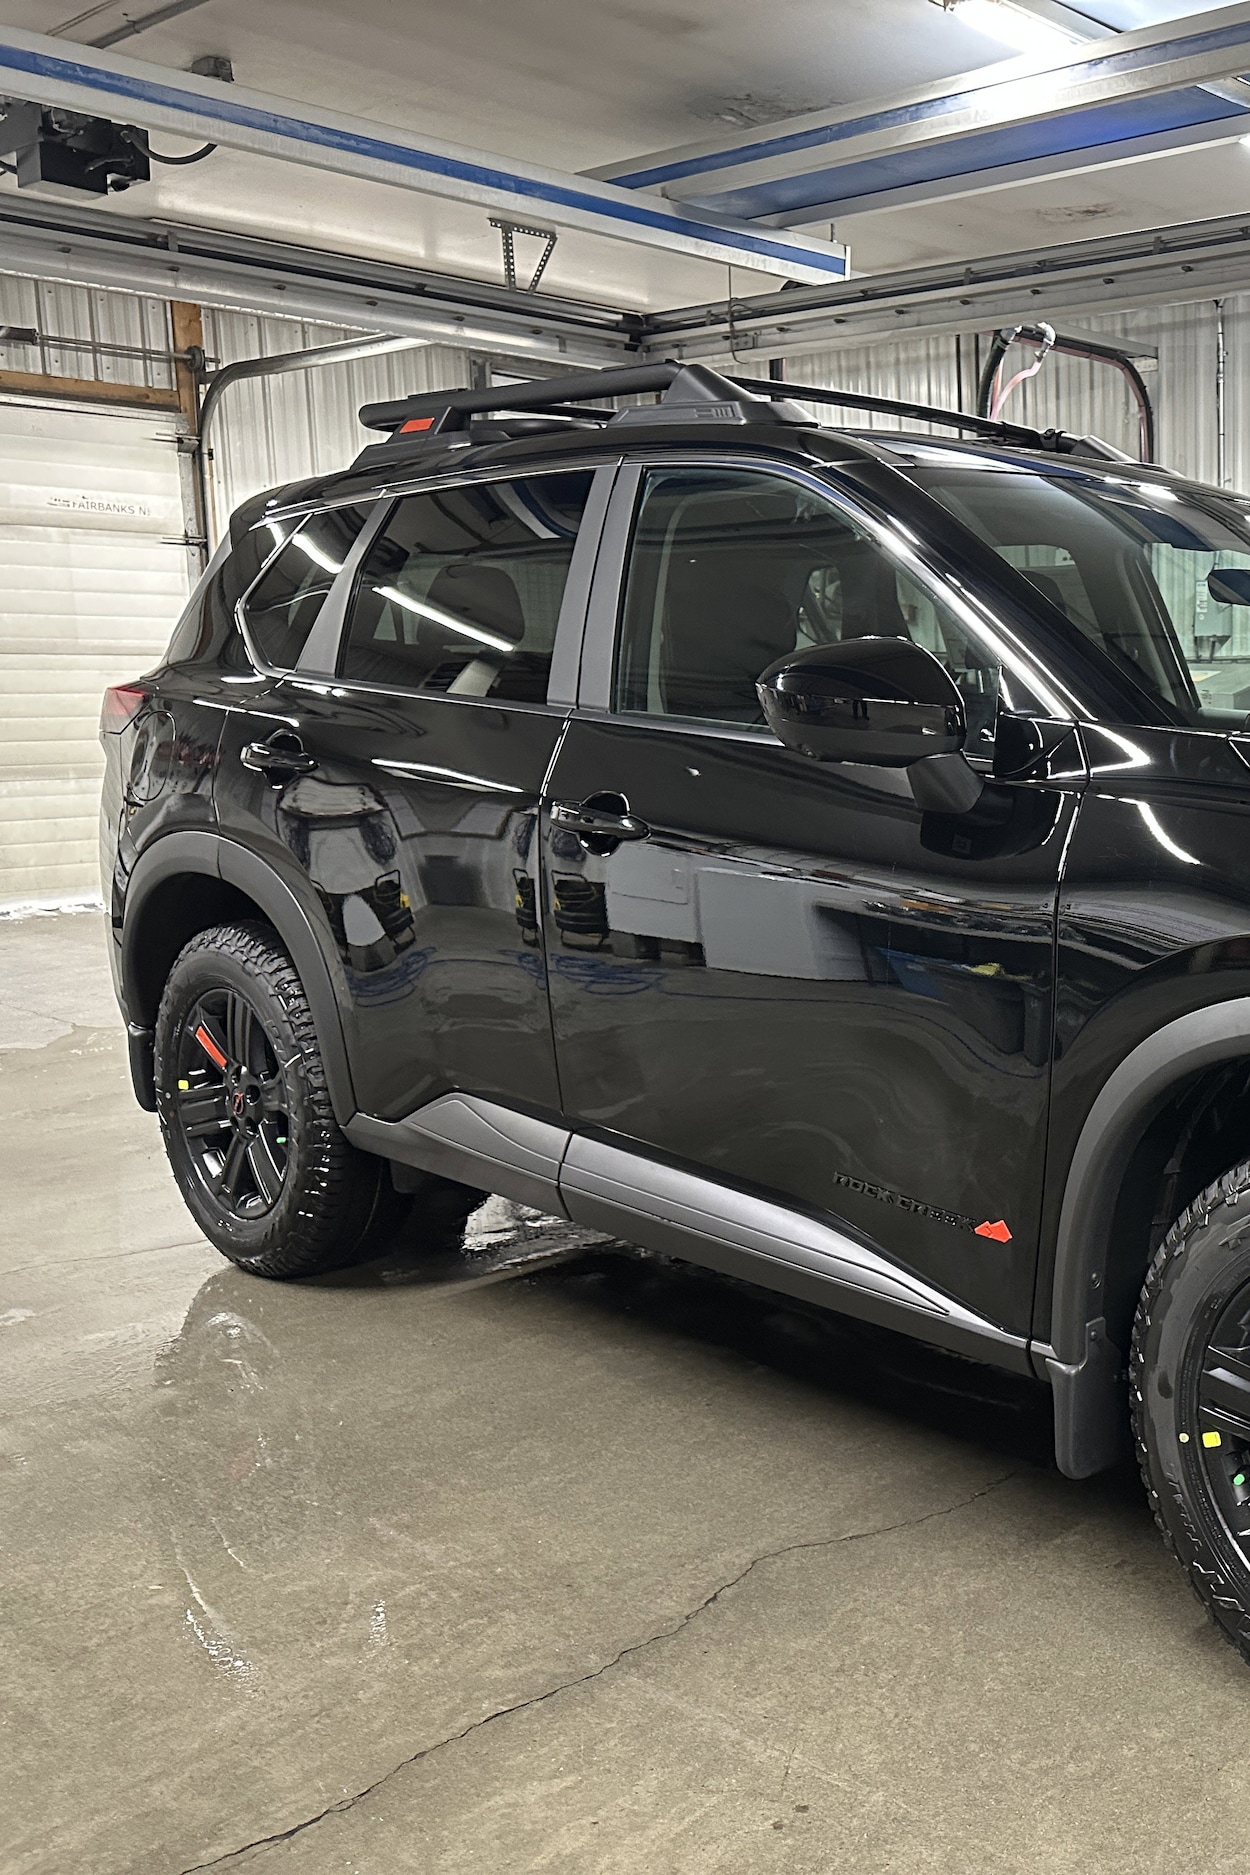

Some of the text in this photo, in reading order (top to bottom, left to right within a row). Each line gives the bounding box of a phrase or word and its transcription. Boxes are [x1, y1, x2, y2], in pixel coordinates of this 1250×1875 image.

[72, 501, 135, 515] FAIRBANKS
[832, 1171, 976, 1233] ROCK CREEK
